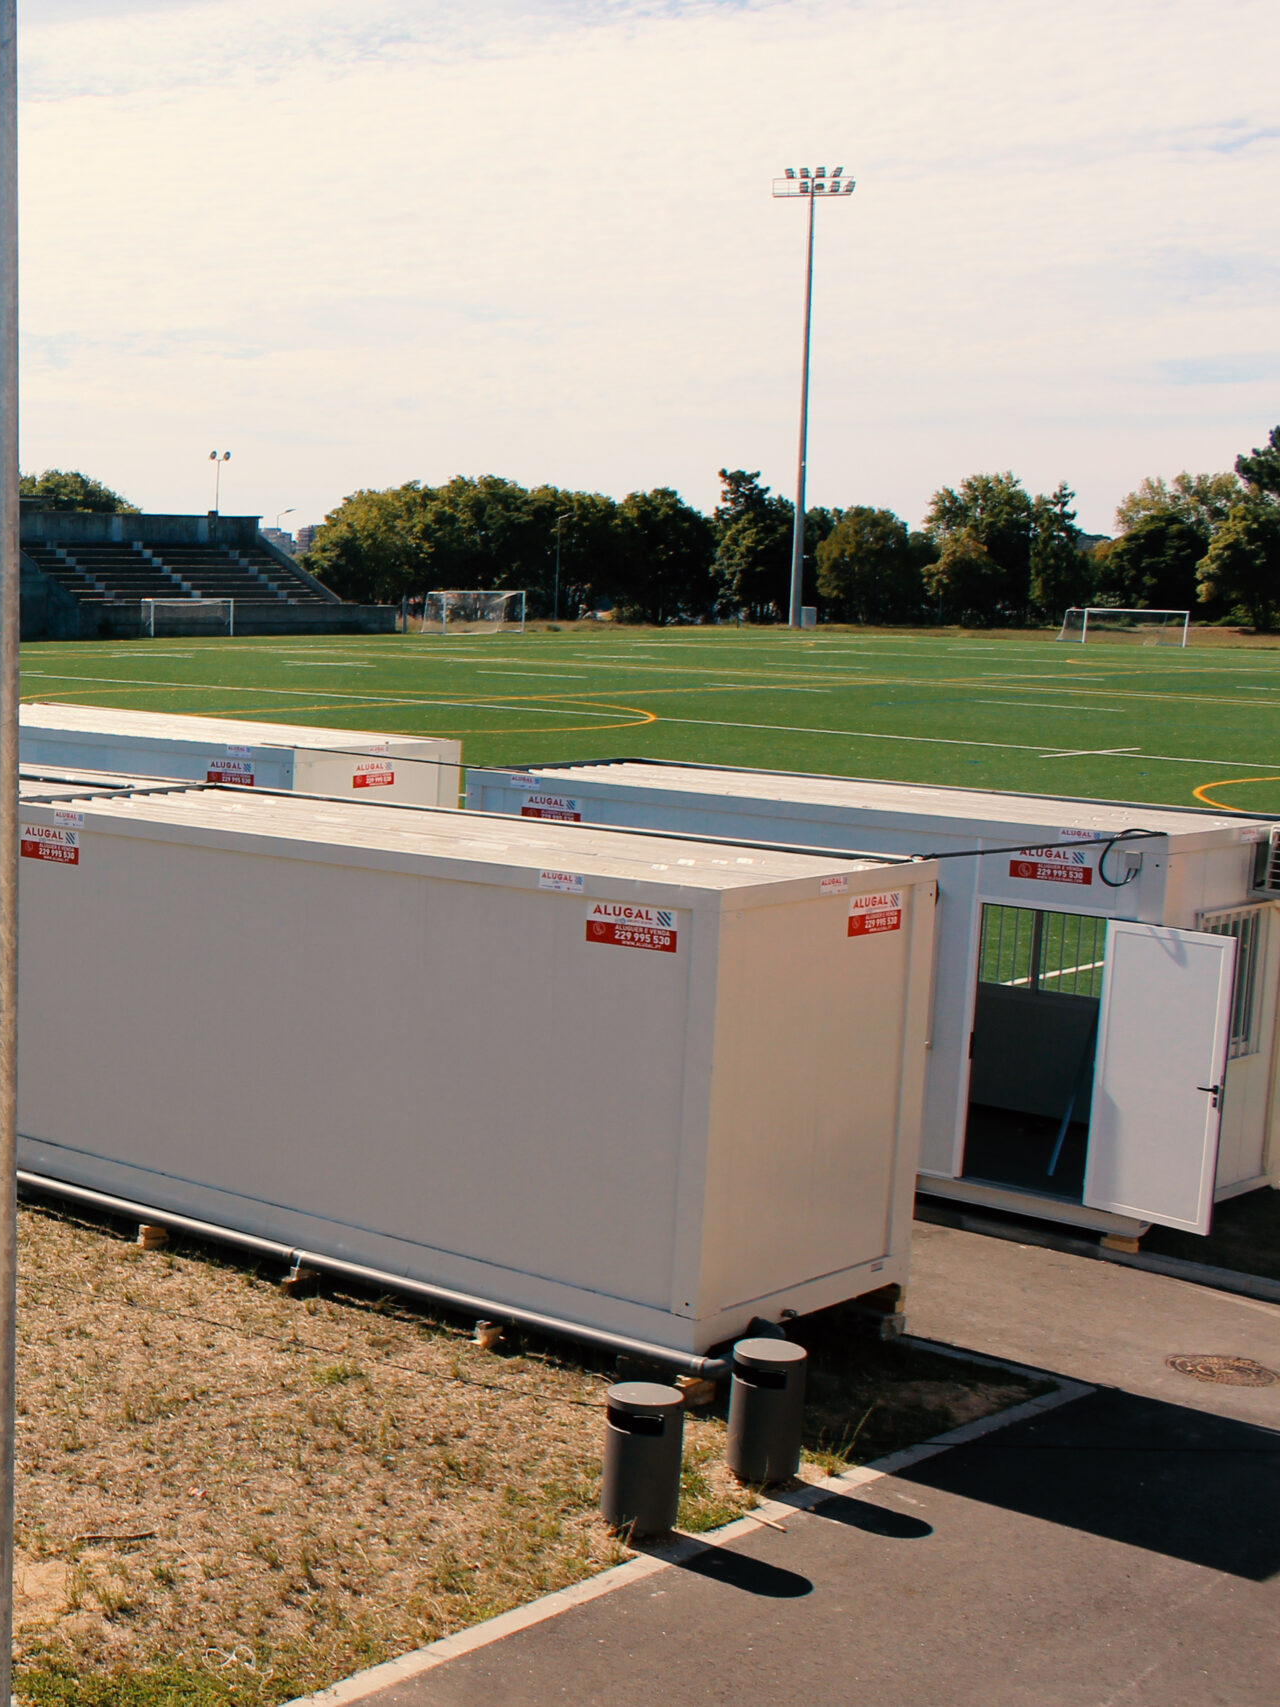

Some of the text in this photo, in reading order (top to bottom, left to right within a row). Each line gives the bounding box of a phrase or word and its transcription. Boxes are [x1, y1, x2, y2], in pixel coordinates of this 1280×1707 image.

[211, 761, 242, 770] ALUGAL
[355, 763, 385, 771] ALUGAL
[528, 796, 564, 807] ALUGAL
[25, 827, 64, 840] ALUGAL
[1061, 829, 1092, 838] ALUGAL
[38, 847, 50, 856] 229
[51, 849, 63, 858] 995
[63, 851, 75, 860] 530
[1019, 847, 1070, 860] ALUGAL
[541, 871, 573, 882] ALUGAL
[1037, 867, 1052, 876] 229
[1053, 869, 1068, 878] 995
[1068, 871, 1084, 880] 530
[853, 895, 889, 909] ALUGAL
[592, 904, 654, 922] ALUGAL
[614, 930, 671, 946] 229 995 530
